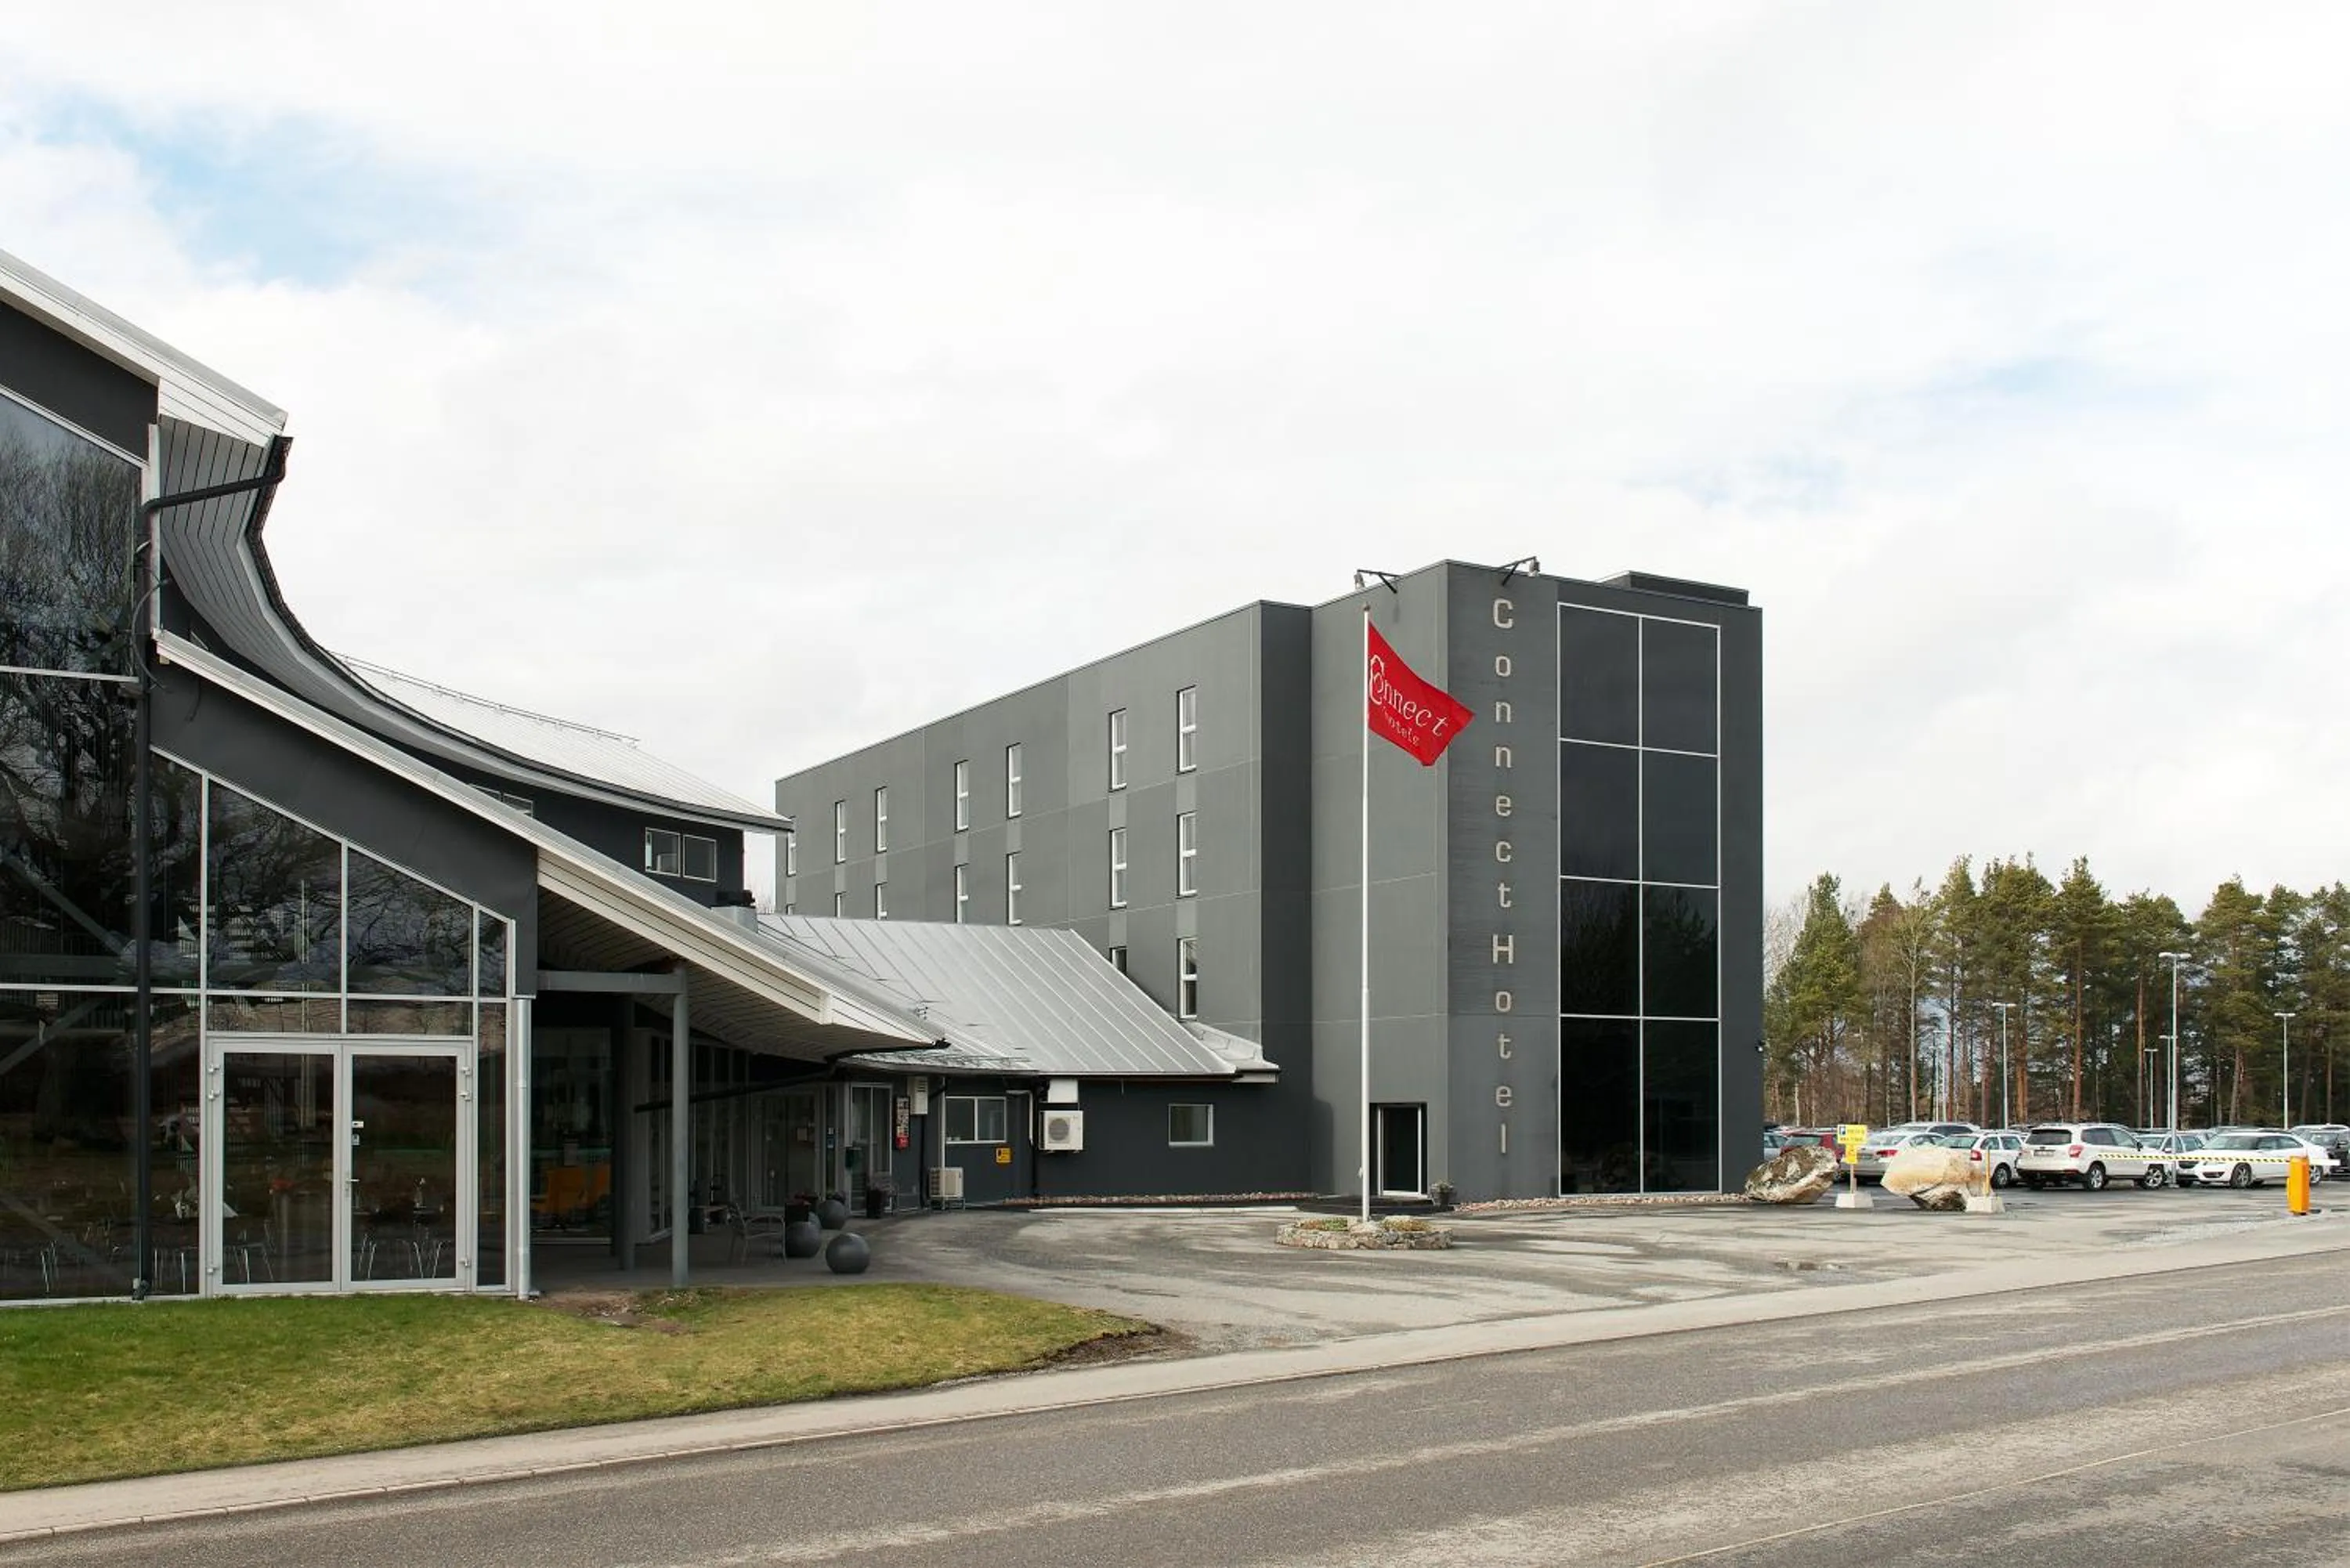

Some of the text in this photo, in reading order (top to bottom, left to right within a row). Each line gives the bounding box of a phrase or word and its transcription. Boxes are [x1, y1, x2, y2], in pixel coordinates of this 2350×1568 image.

[1369, 654, 1448, 737] Connect
[1492, 598, 1514, 1154] Connect Hotel
